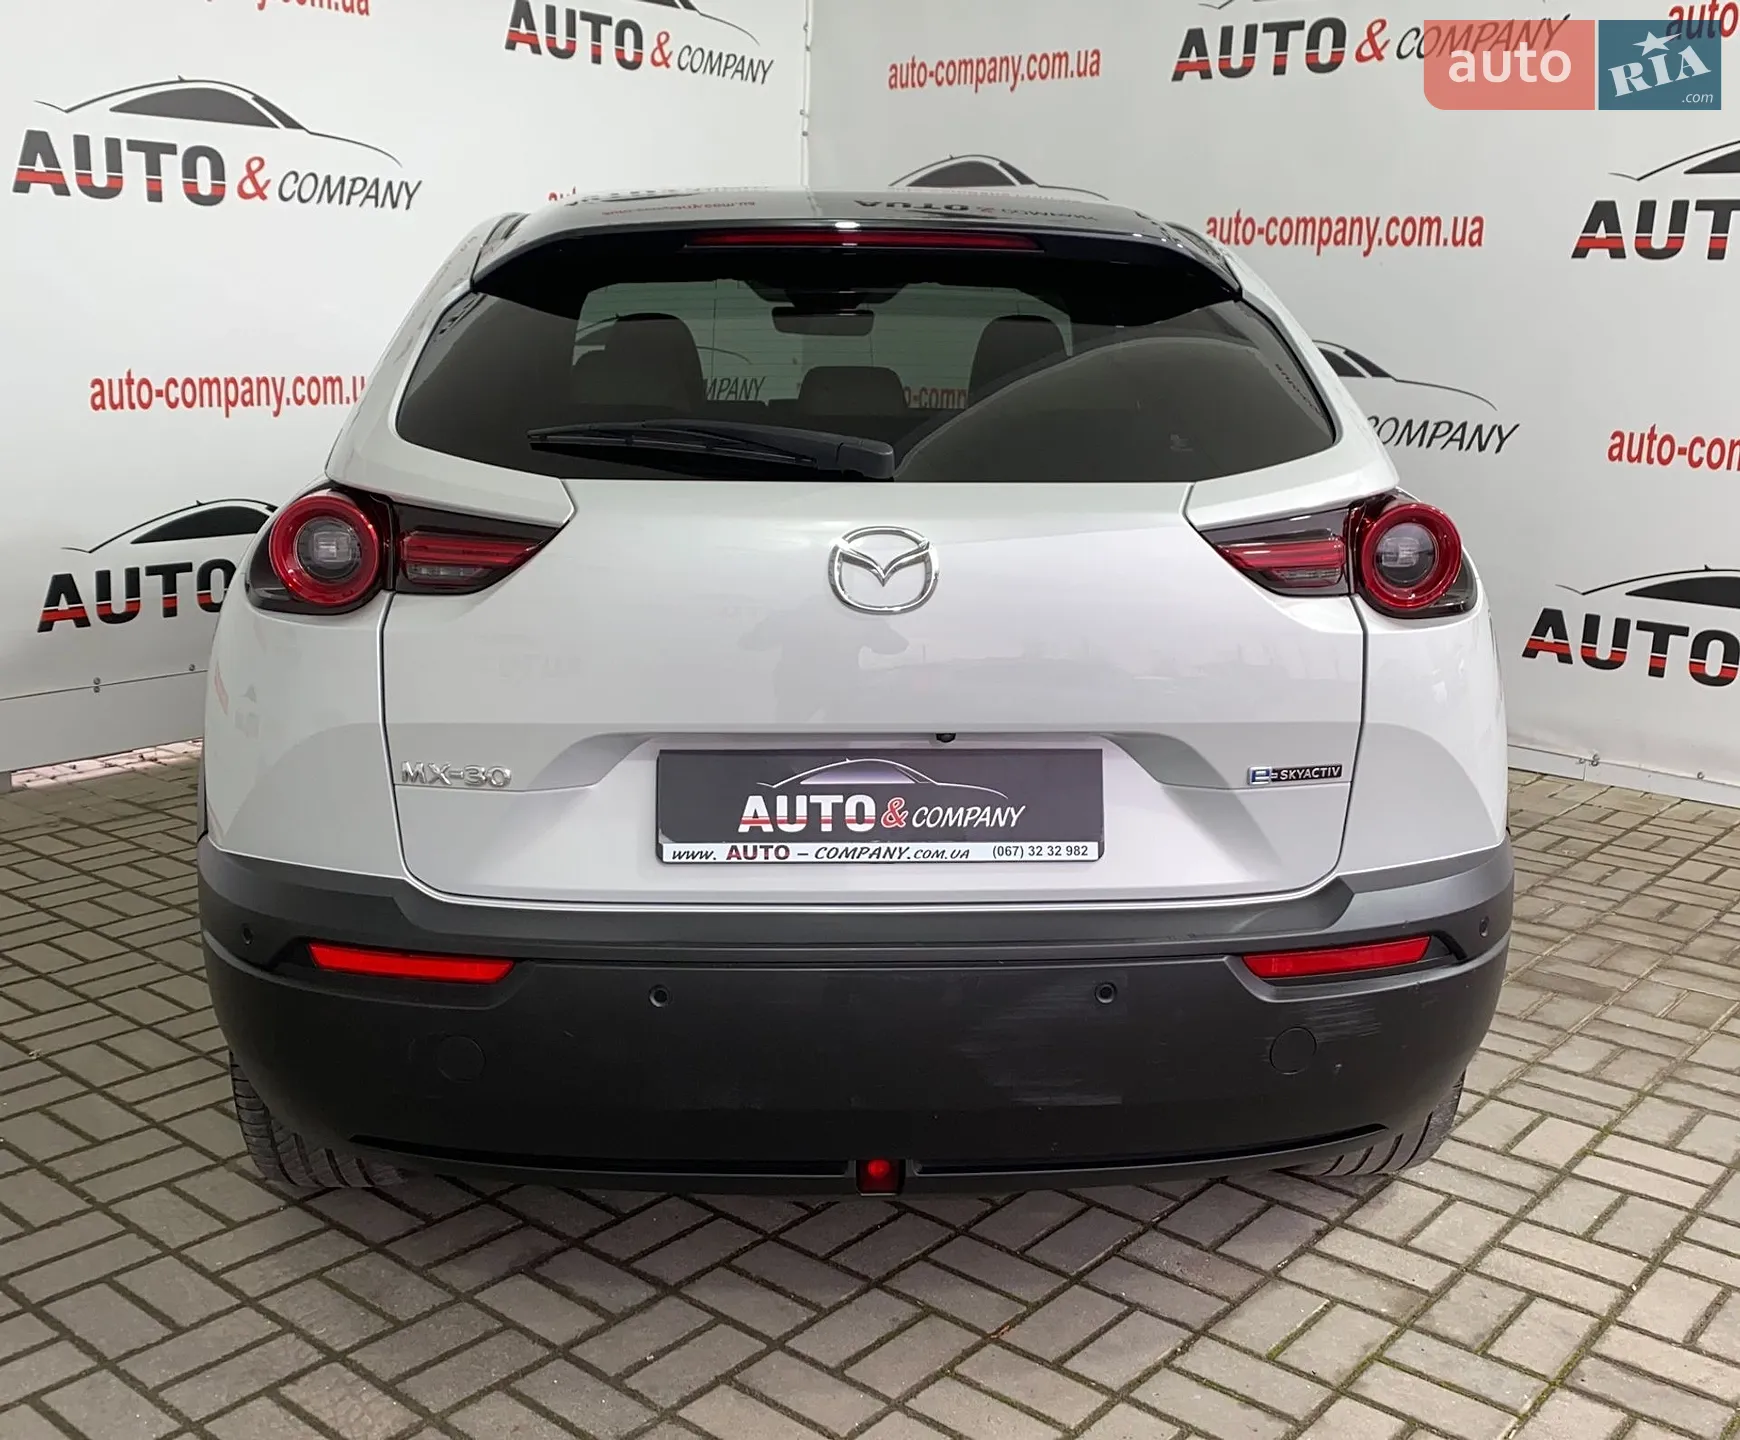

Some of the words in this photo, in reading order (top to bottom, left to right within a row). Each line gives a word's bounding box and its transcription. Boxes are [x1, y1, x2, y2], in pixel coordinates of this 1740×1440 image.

[504, 0, 644, 71] AUTO
[649, 31, 673, 68] &
[677, 44, 774, 85] COMPANY
[888, 48, 1101, 93] auto-company.com.ua
[1171, 17, 1347, 81] AUTO
[1354, 18, 1390, 63] &
[1395, 14, 1571, 60] COMPANY
[12, 129, 226, 206] AUTO
[236, 156, 272, 201] &
[278, 170, 423, 210] COMPANY
[1206, 208, 1485, 258] auto-company.com.ua
[37, 558, 238, 633] AUTO
[1522, 607, 1740, 687] AUTO
[401, 761, 512, 787] MX-30
[737, 794, 876, 832] AUTO
[880, 797, 907, 829] &
[911, 803, 1027, 829] COMPANY
[992, 845, 1024, 859] (067)
[1028, 845, 1043, 857] 32
[1047, 845, 1062, 857] 32
[1066, 845, 1089, 857] 982
